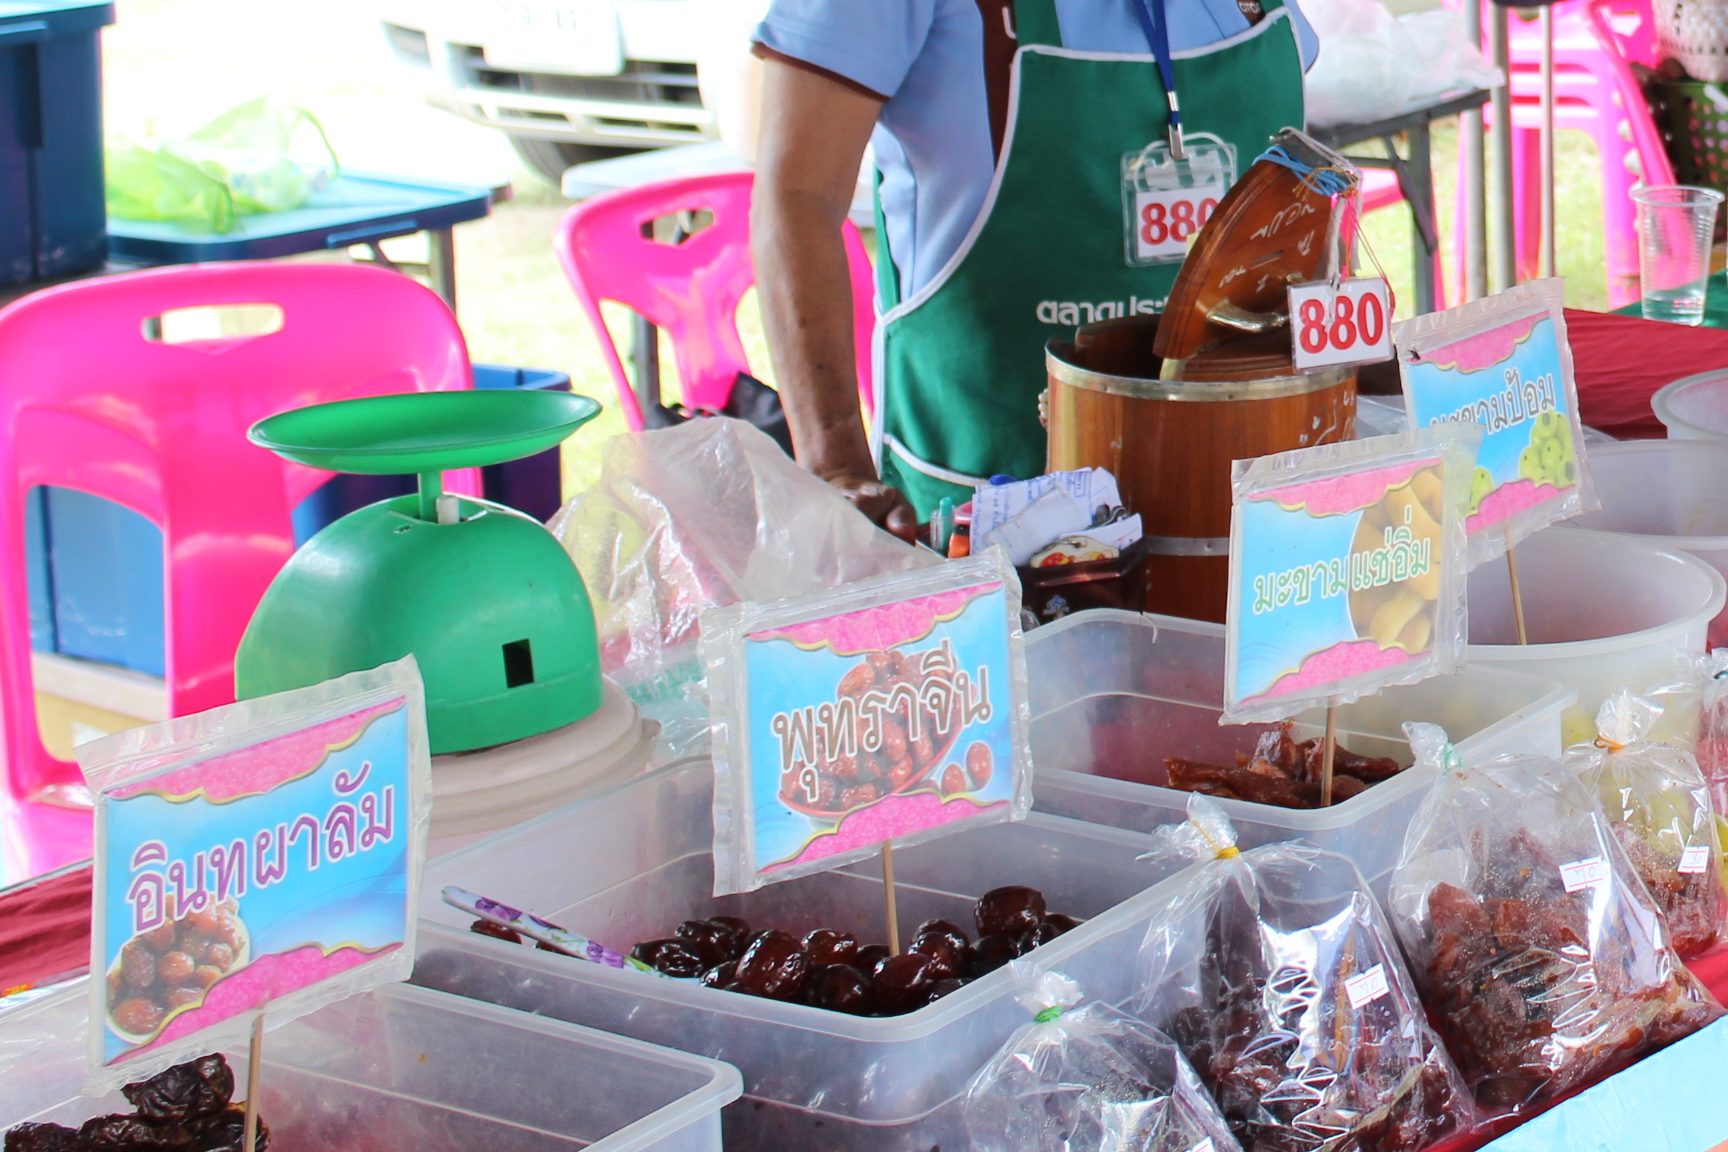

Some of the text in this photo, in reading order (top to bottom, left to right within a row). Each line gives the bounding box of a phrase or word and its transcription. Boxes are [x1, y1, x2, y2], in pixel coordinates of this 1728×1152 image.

[1036, 295, 1170, 326] ตลาดประ
[1300, 292, 1384, 354] 880
[1253, 506, 1432, 615] มะขามแช่อิ่ม
[772, 640, 992, 802] พุทราจีน
[127, 762, 393, 934] อินทผาลัม
[1574, 865, 1596, 882] 70
[1358, 977, 1379, 995] 70
